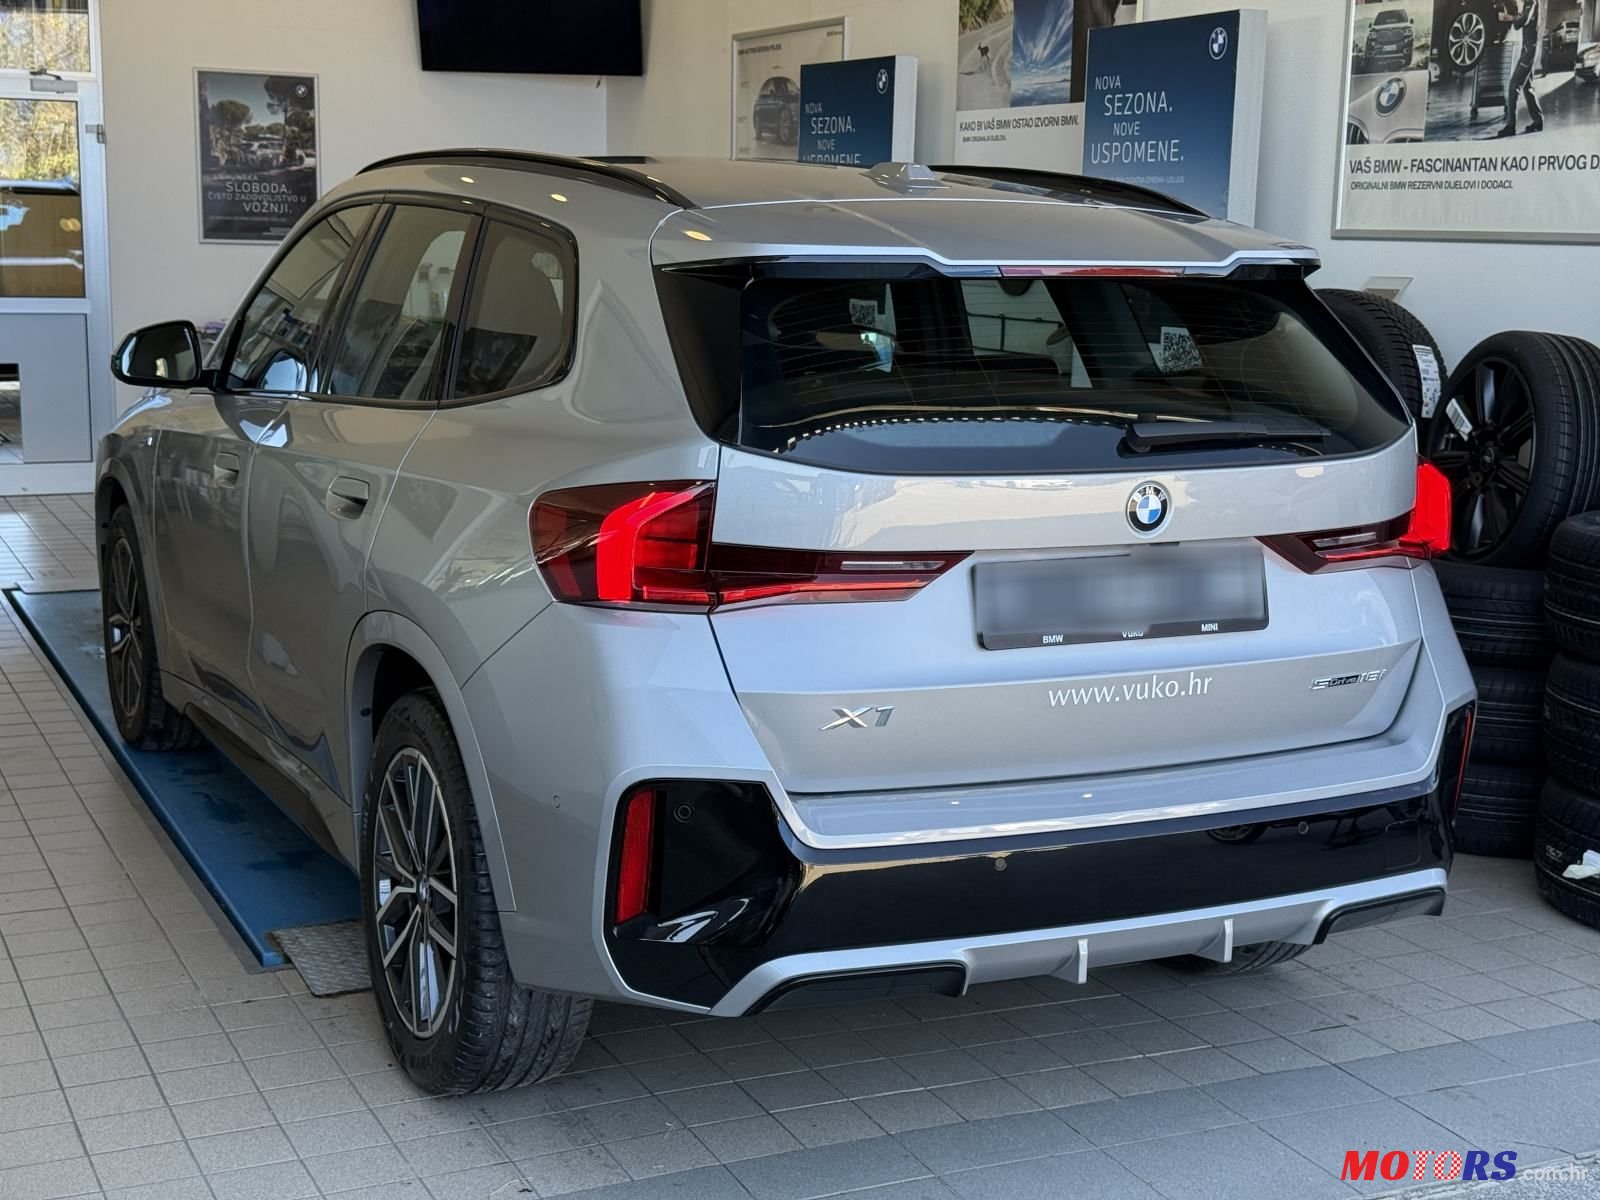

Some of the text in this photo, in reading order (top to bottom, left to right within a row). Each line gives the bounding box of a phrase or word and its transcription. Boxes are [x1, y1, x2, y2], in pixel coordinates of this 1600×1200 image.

[1095, 75, 1121, 90] NOVA
[805, 103, 823, 114] NOVA
[1104, 91, 1173, 116] SEZONA.
[811, 116, 856, 135] SEZONA.
[960, 121, 976, 132] KAKO
[983, 117, 995, 130] VAŠ
[996, 119, 1011, 130] BMW
[1012, 118, 1034, 129] OSTAO
[1034, 116, 1060, 128] IZVORNI
[1113, 121, 1140, 136] NOVE
[817, 139, 836, 150] NOVE
[1091, 139, 1184, 164] USPOMENE.
[1349, 156, 1371, 174] VAŠ
[1373, 159, 1402, 174] BMW
[1410, 157, 1498, 173] FASCINANTAN
[1500, 156, 1529, 172] KAO
[1531, 156, 1535, 171] I
[1538, 154, 1587, 171] PRVOG
[1590, 154, 1600, 170] D
[225, 181, 292, 194] SLOBODA.
[1350, 181, 1388, 190] ORIGINALNI
[1389, 181, 1407, 190] BMW
[1407, 180, 1443, 190] REZERVNI
[1444, 180, 1476, 190] DIJELOVI
[243, 201, 293, 214] VOŽNJI.
[1042, 634, 1063, 644] BMW
[1201, 623, 1218, 632] MINI
[1049, 671, 1213, 707] www.vuko.hr
[819, 704, 895, 731] X1
